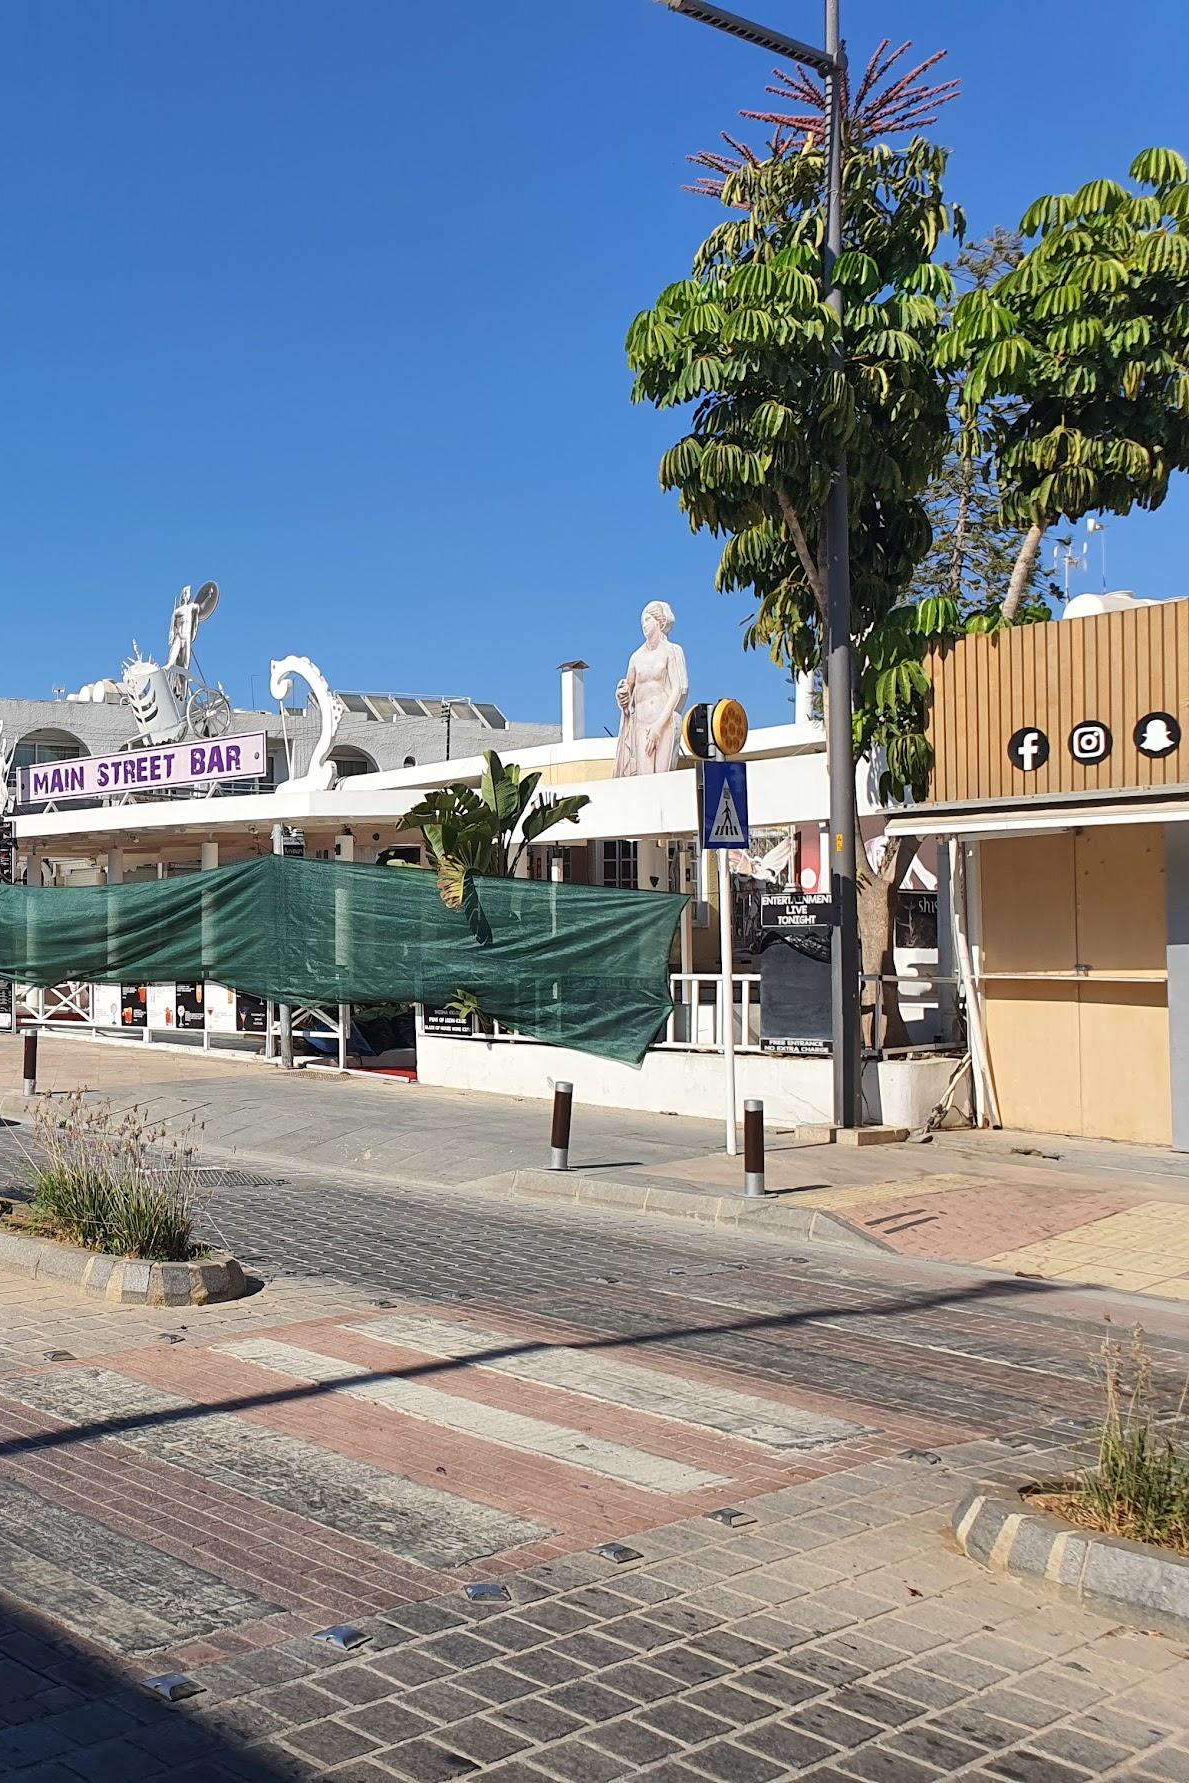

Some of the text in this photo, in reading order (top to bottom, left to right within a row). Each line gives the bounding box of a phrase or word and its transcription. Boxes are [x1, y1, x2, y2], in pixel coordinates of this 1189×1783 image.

[33, 744, 242, 795] MAIN STREET BAR
[786, 905, 808, 915] LIVE
[777, 914, 817, 925] TONIGHT
